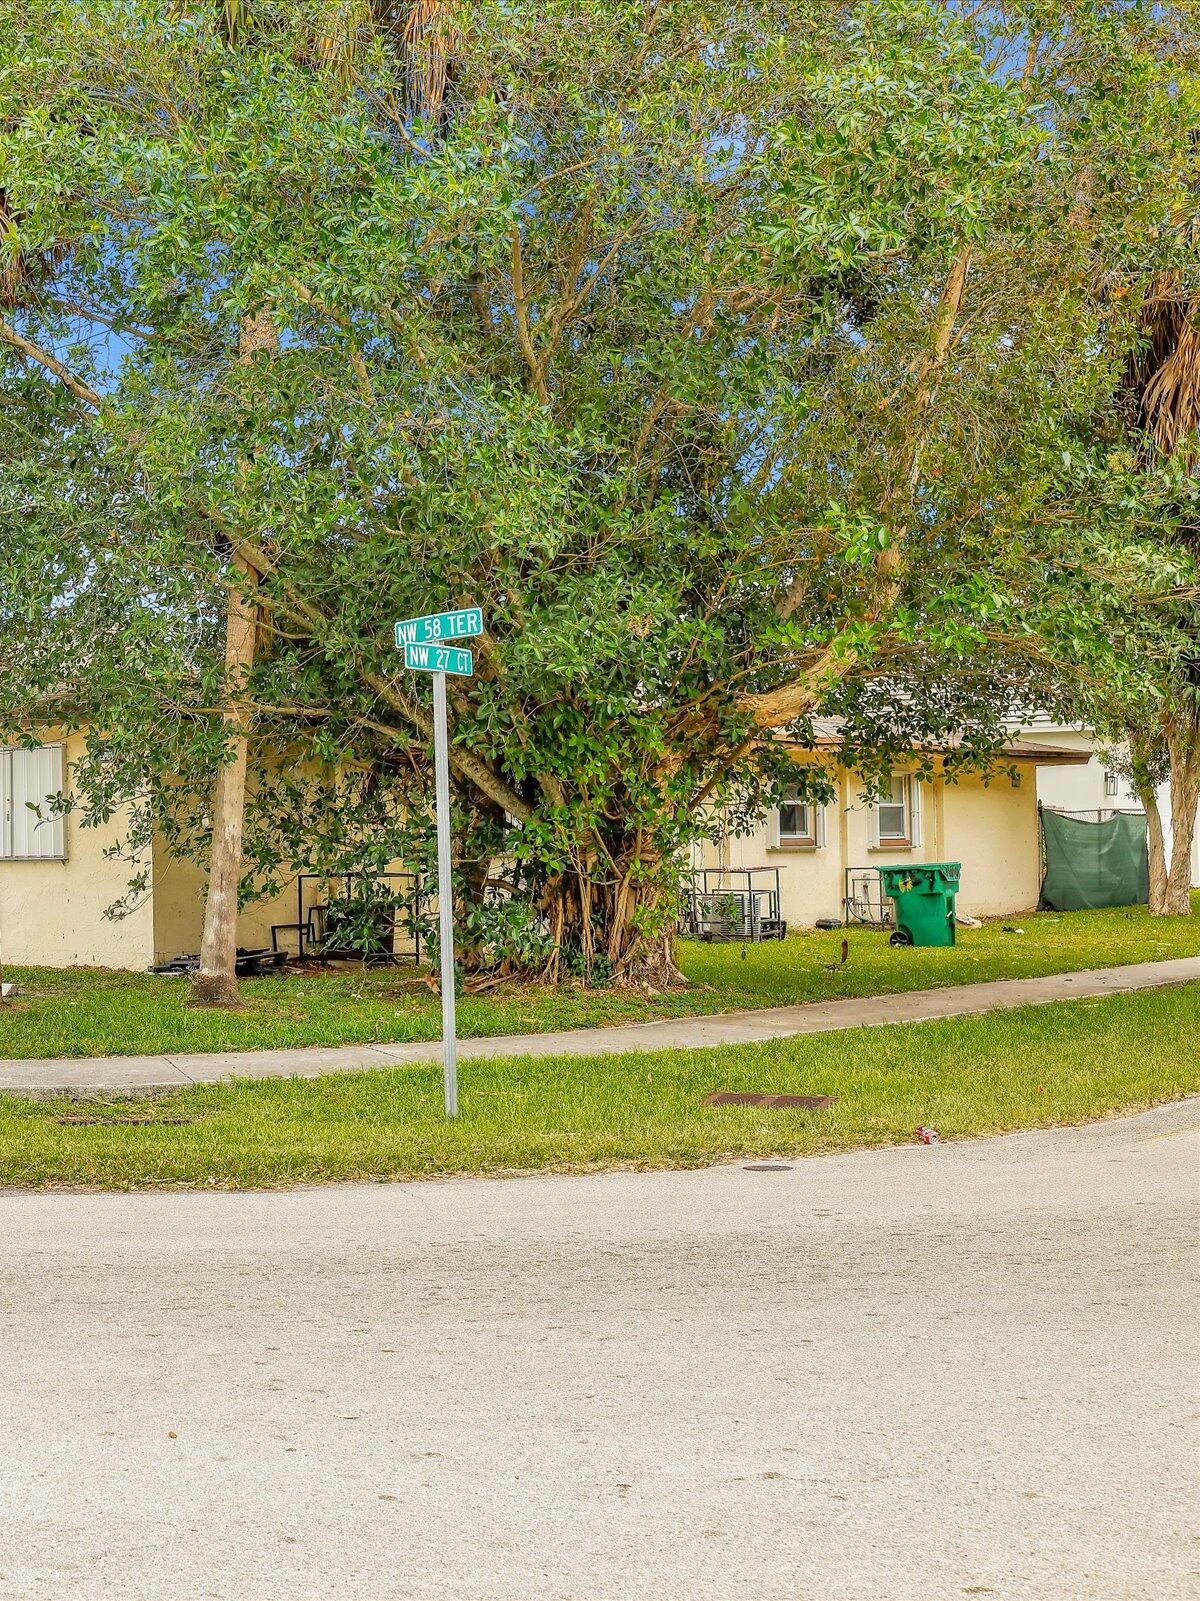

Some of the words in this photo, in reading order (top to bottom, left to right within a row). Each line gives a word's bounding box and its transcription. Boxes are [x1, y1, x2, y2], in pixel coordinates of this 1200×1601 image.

[397, 623, 417, 645] NW
[424, 618, 441, 639] 58
[448, 613, 478, 635] TER
[409, 646, 429, 667] NW
[435, 650, 450, 669] 27
[457, 652, 469, 672] CT
